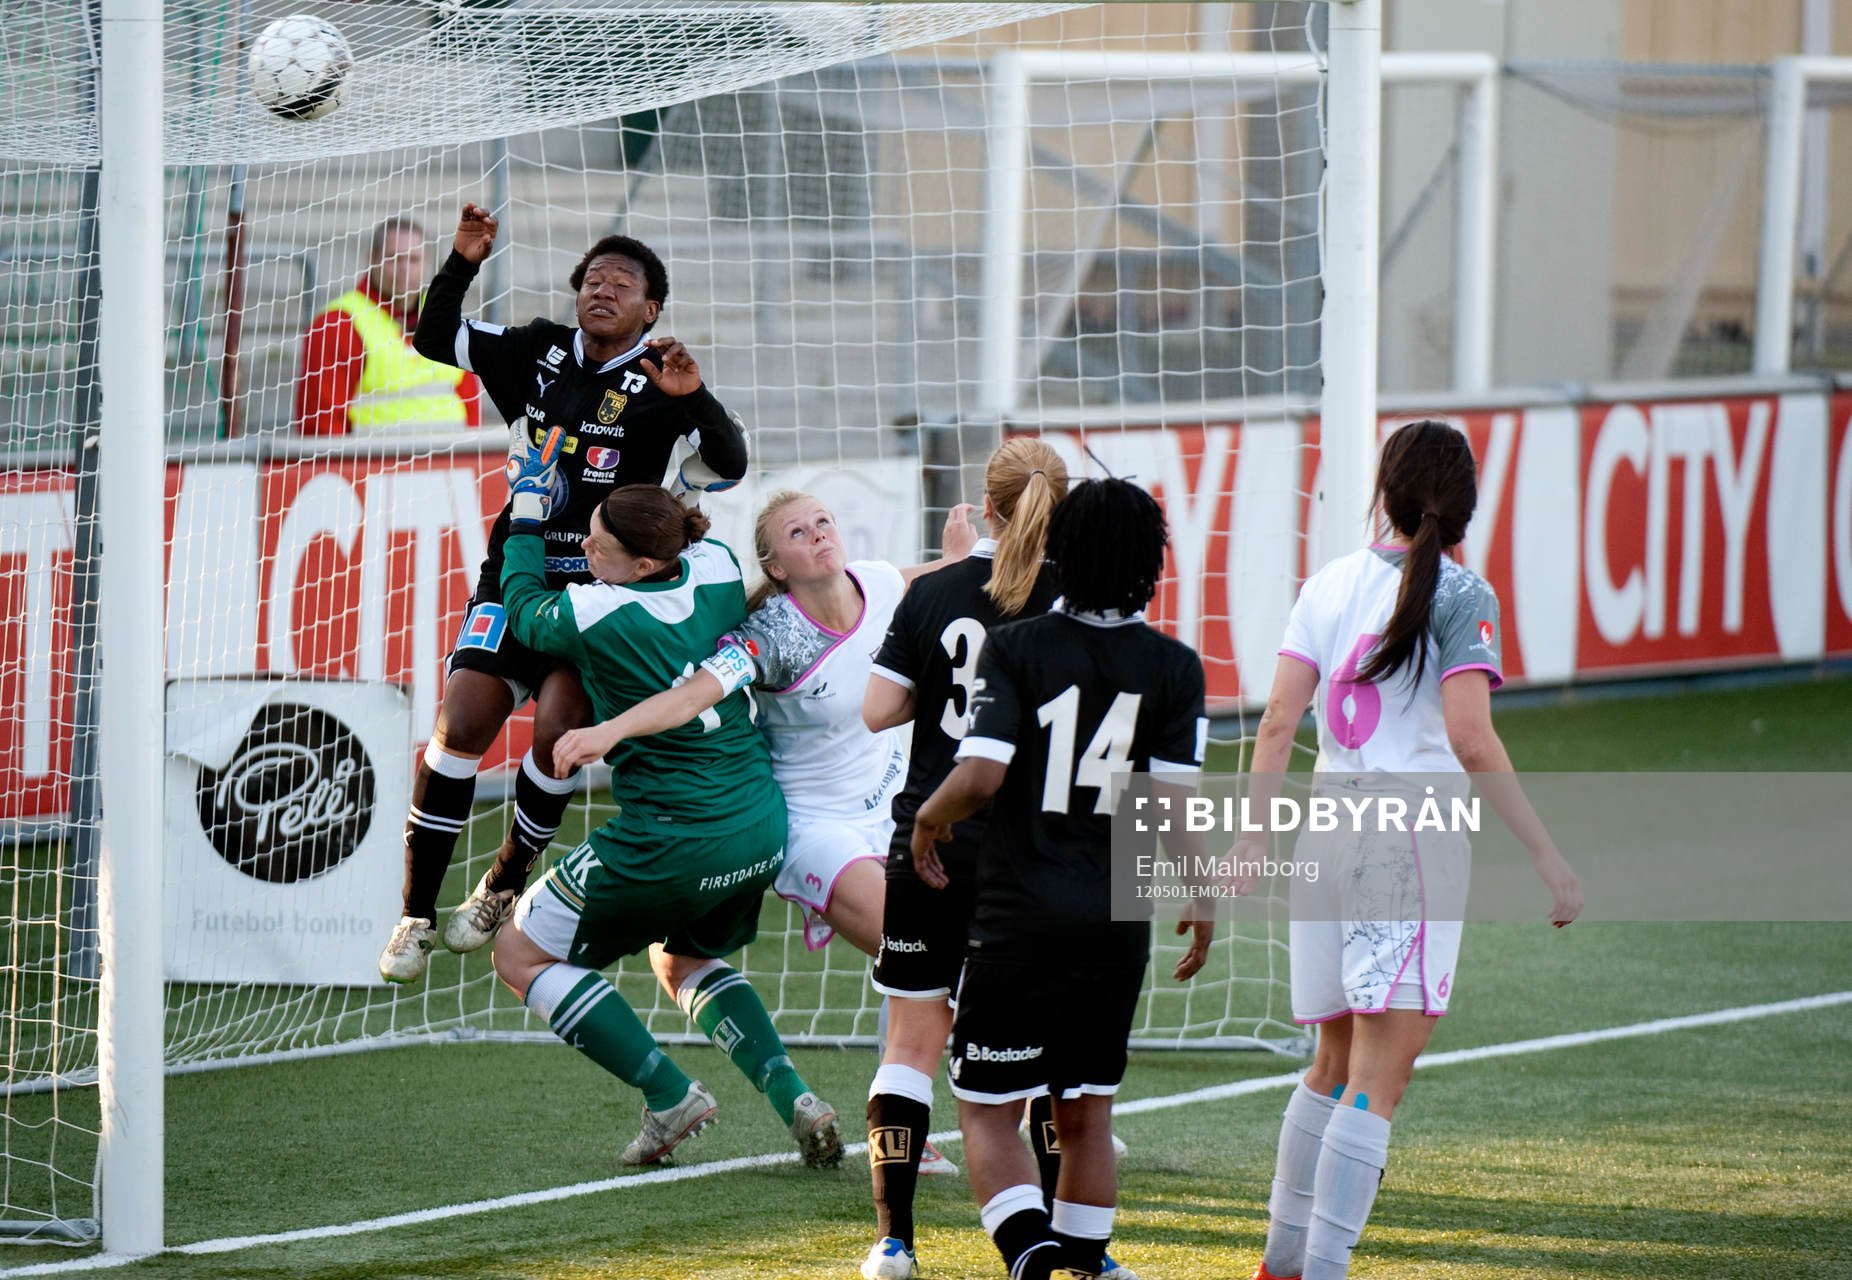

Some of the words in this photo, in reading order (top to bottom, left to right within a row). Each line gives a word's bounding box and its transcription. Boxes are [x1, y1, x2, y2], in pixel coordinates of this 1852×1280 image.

[620, 370, 648, 394] T3
[580, 421, 625, 438] knowit
[583, 467, 615, 478] fronta
[1584, 403, 1772, 645] CITY
[707, 655, 735, 677] LIT
[720, 645, 747, 671] IPS
[940, 617, 987, 740] 3
[1326, 633, 1382, 750] 6
[1037, 684, 1142, 816] 14
[805, 872, 822, 894] 3
[192, 910, 284, 932] Futebol
[294, 911, 374, 935] bonito
[1437, 971, 1450, 998] 6
[869, 1131, 905, 1159] XL
